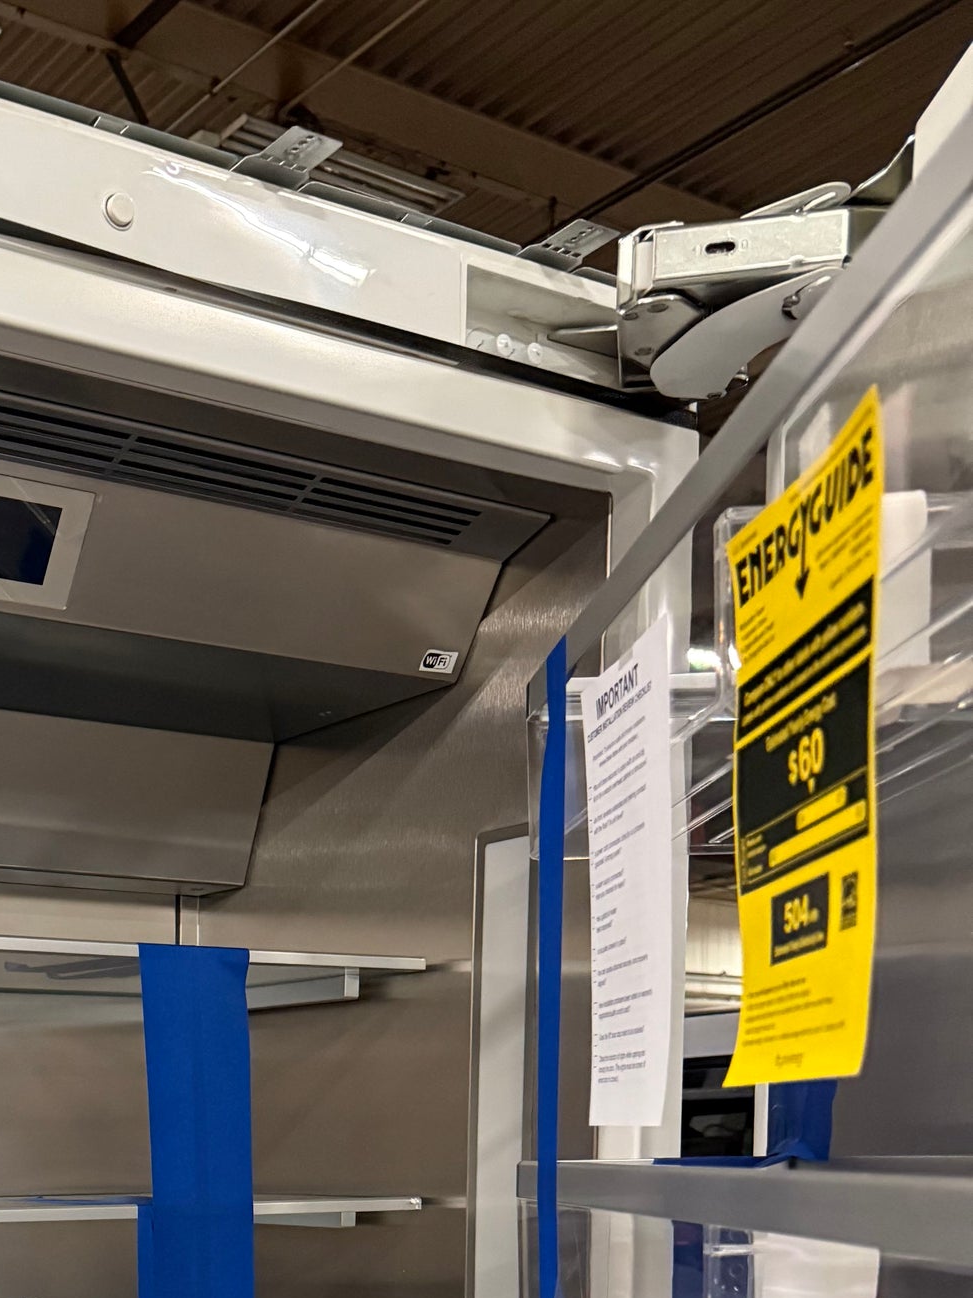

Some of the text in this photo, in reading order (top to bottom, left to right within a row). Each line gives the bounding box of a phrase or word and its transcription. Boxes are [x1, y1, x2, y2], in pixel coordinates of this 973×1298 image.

[596, 663, 639, 720] IMPORTANT
[788, 728, 825, 786] $60
[783, 893, 810, 935] 504
